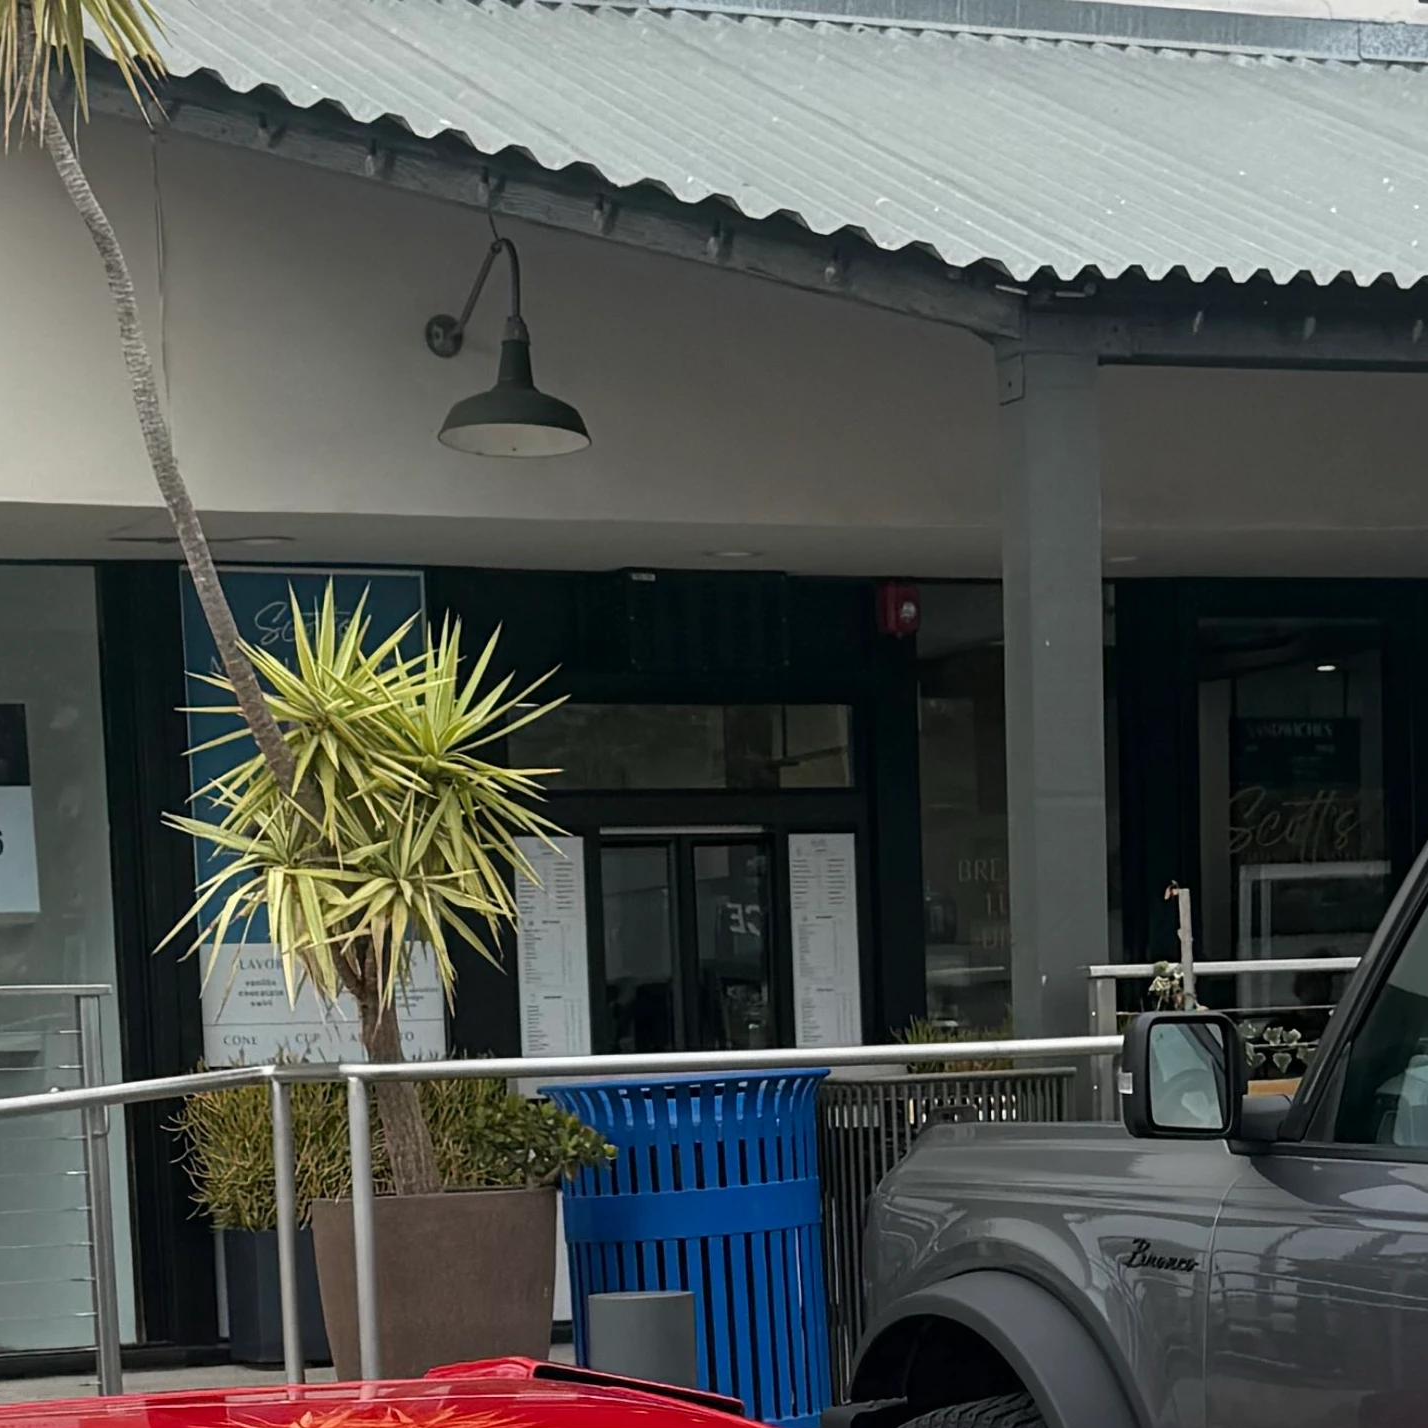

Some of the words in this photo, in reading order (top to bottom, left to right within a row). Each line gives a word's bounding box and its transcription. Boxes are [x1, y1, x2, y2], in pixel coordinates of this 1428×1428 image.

[223, 1034, 258, 1046] CONE
[295, 1032, 321, 1044] CUP
[1121, 1238, 1199, 1272] Bronco
